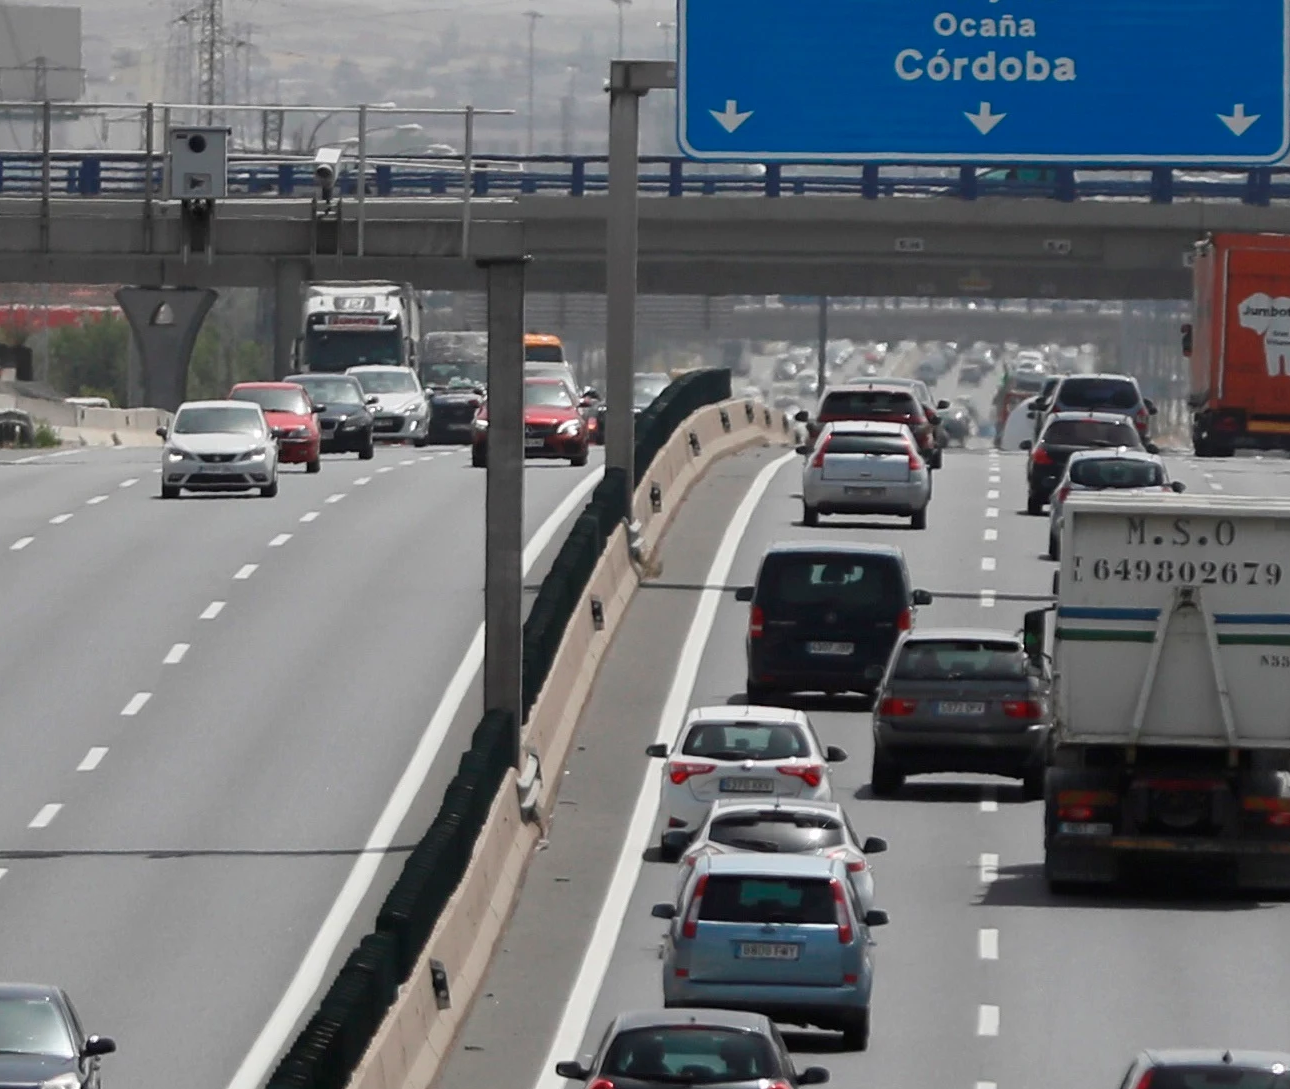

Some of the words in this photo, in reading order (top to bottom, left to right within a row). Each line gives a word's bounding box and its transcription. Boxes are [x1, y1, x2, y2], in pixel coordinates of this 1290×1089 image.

[933, 12, 1037, 38] Ocaña
[894, 48, 1077, 82] Córdoba
[1093, 556, 1283, 587] 649802679
